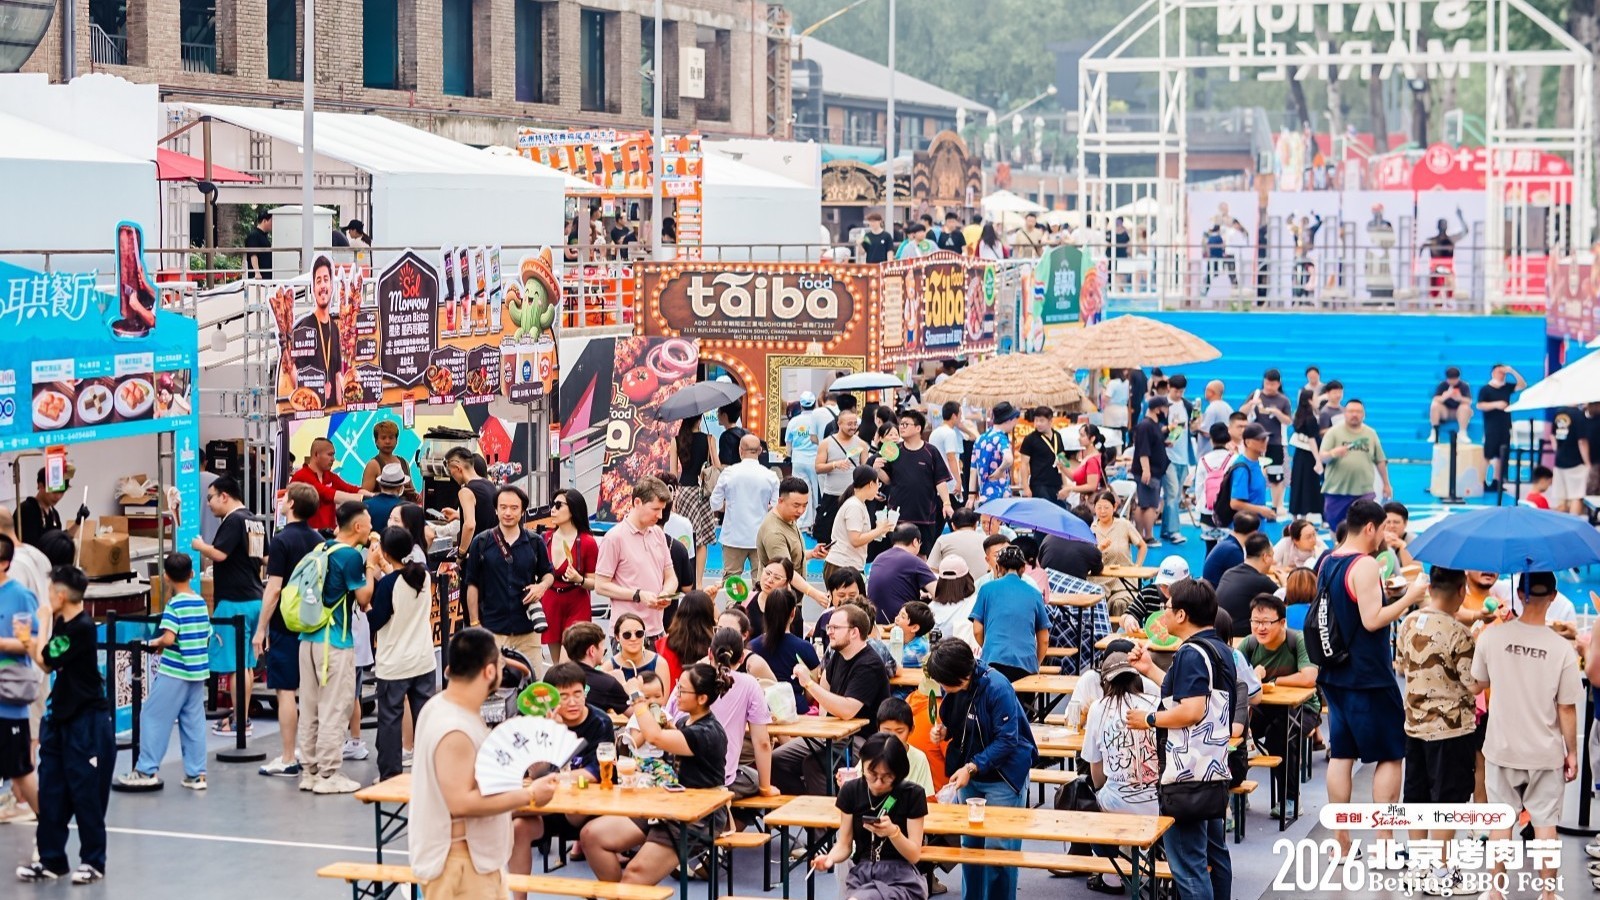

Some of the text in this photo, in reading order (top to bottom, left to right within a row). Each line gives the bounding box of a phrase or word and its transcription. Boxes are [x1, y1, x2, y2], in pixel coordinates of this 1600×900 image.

[798, 276, 833, 290] food
[951, 266, 964, 287] food
[402, 274, 421, 298] Sol
[388, 291, 429, 313] Morrow
[388, 312, 412, 324] Mexican
[412, 310, 429, 322] Bistro
[1505, 644, 1548, 660] 4EVER
